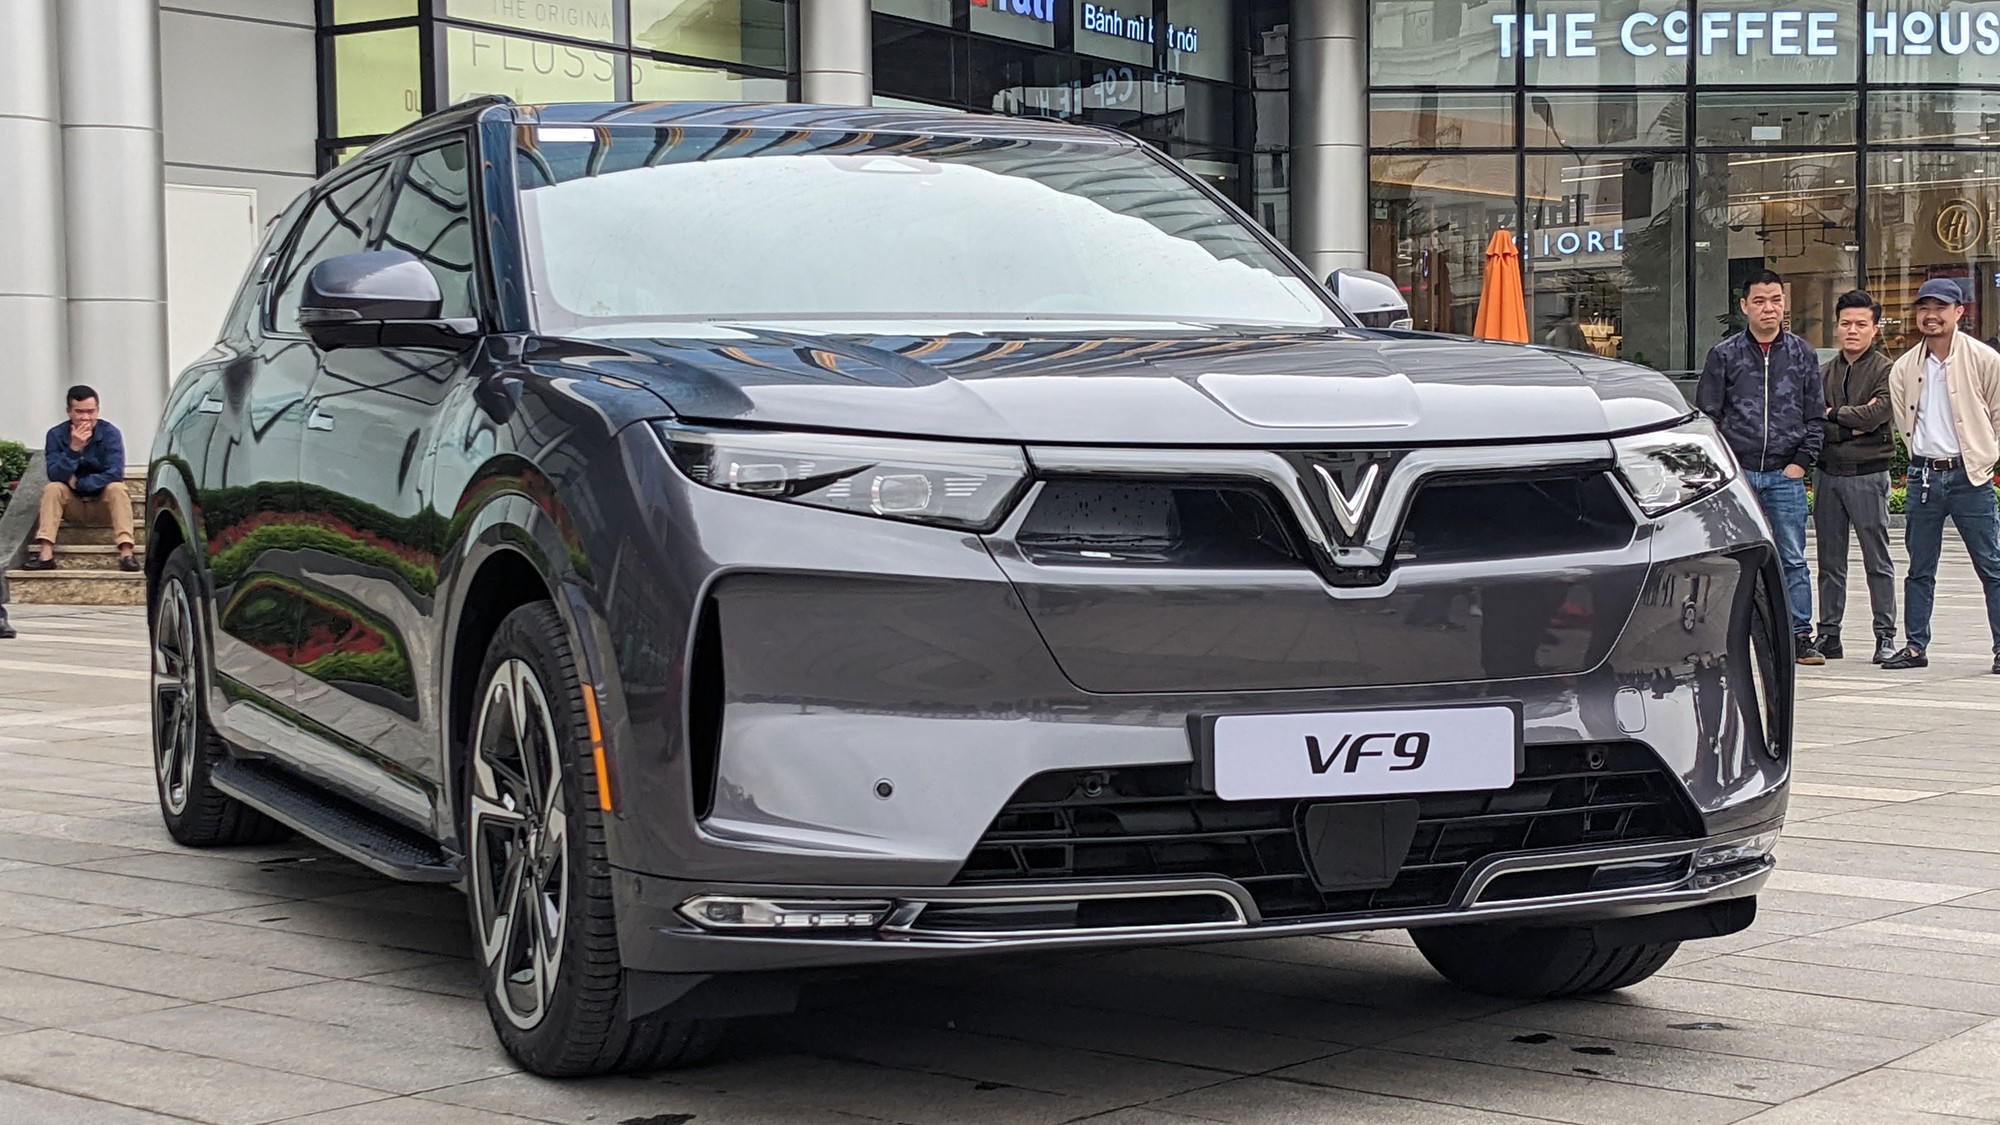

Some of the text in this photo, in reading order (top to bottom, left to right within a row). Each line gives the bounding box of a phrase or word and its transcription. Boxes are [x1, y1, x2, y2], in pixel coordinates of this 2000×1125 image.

[1084, 4, 1123, 36] Bánh
[1126, 15, 1145, 41] mì
[1177, 27, 1197, 53] nói
[1491, 12, 1597, 58] THE
[1620, 10, 1838, 57] COFFEE
[1304, 731, 1430, 775] VF9
